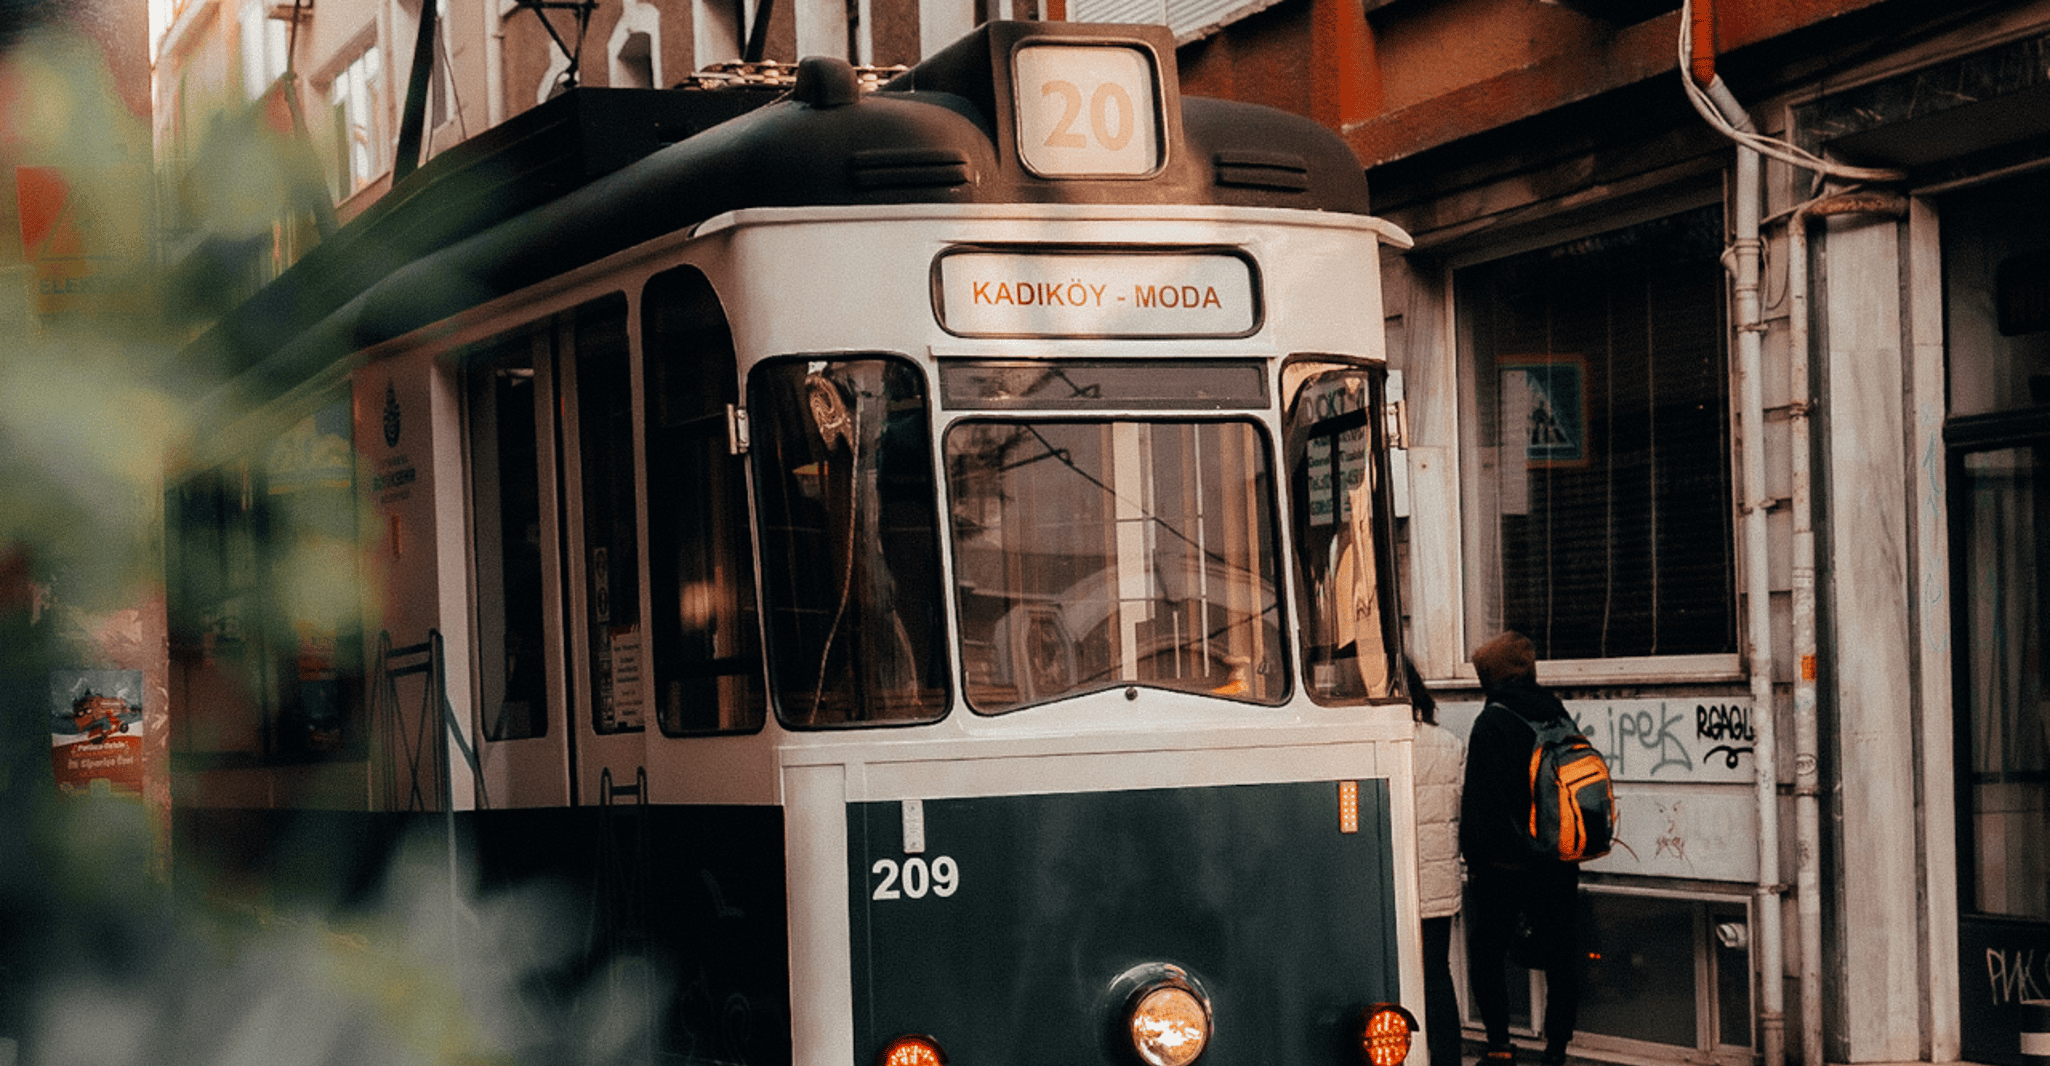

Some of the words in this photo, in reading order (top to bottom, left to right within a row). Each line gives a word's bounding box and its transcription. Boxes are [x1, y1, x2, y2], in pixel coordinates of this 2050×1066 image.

[1041, 80, 1135, 151] 20
[973, 278, 1106, 307] KADIKÖY
[1135, 284, 1222, 309] MODA
[872, 855, 959, 900] 209
